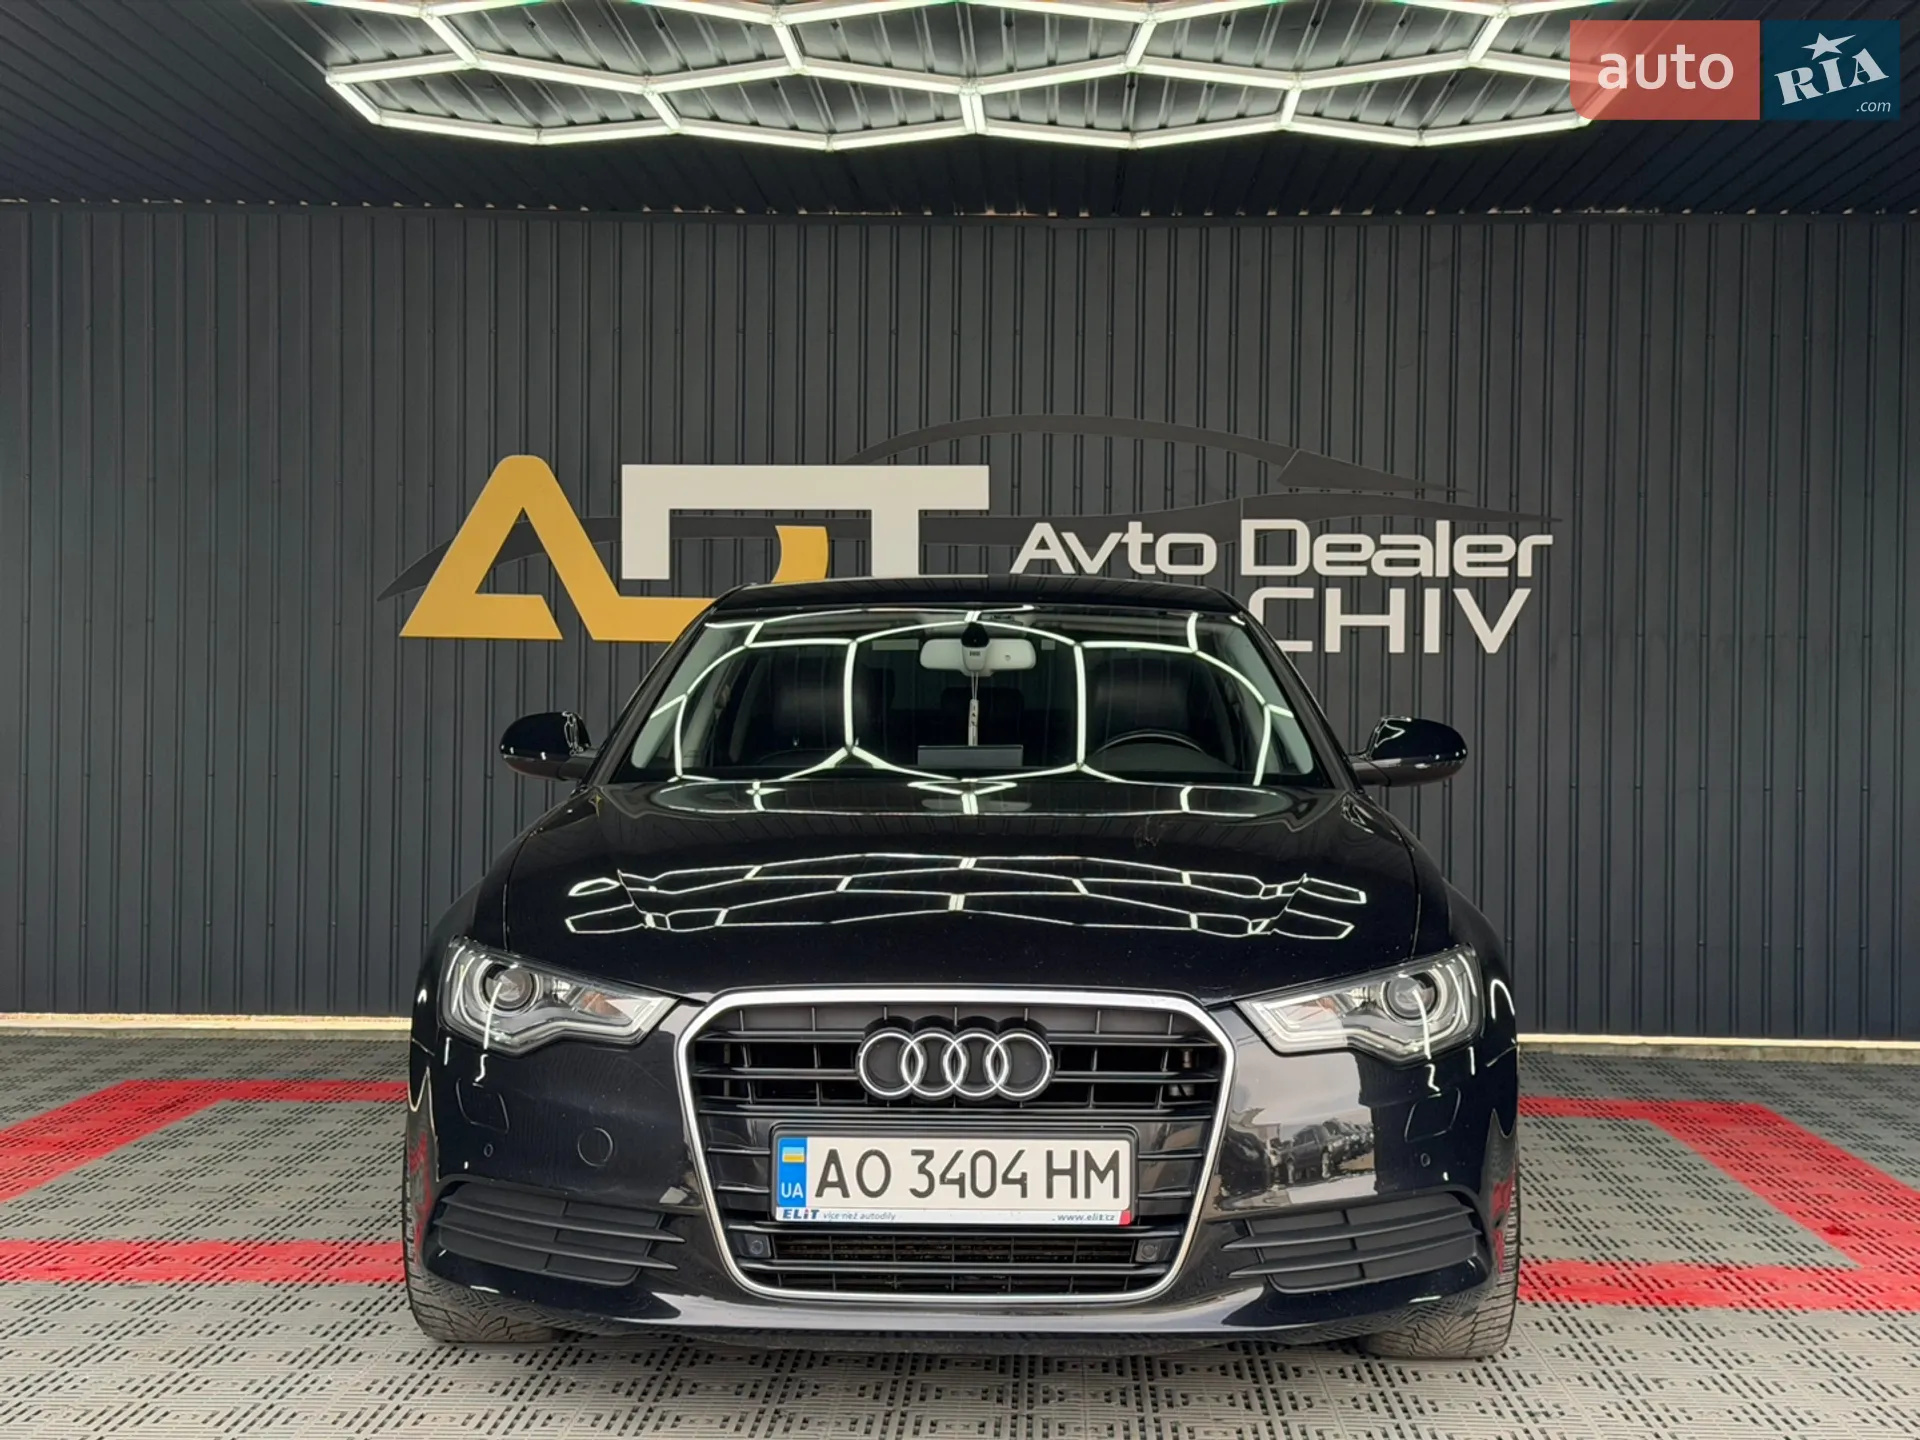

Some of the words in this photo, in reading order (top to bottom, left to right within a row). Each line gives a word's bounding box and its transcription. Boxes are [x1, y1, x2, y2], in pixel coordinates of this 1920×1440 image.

[1009, 521, 1217, 576] Avto
[1240, 519, 1554, 578] Dealer
[781, 1183, 803, 1199] UA
[814, 1148, 892, 1199] AO
[908, 1149, 1028, 1200] 3404
[1045, 1149, 1120, 1200] HM
